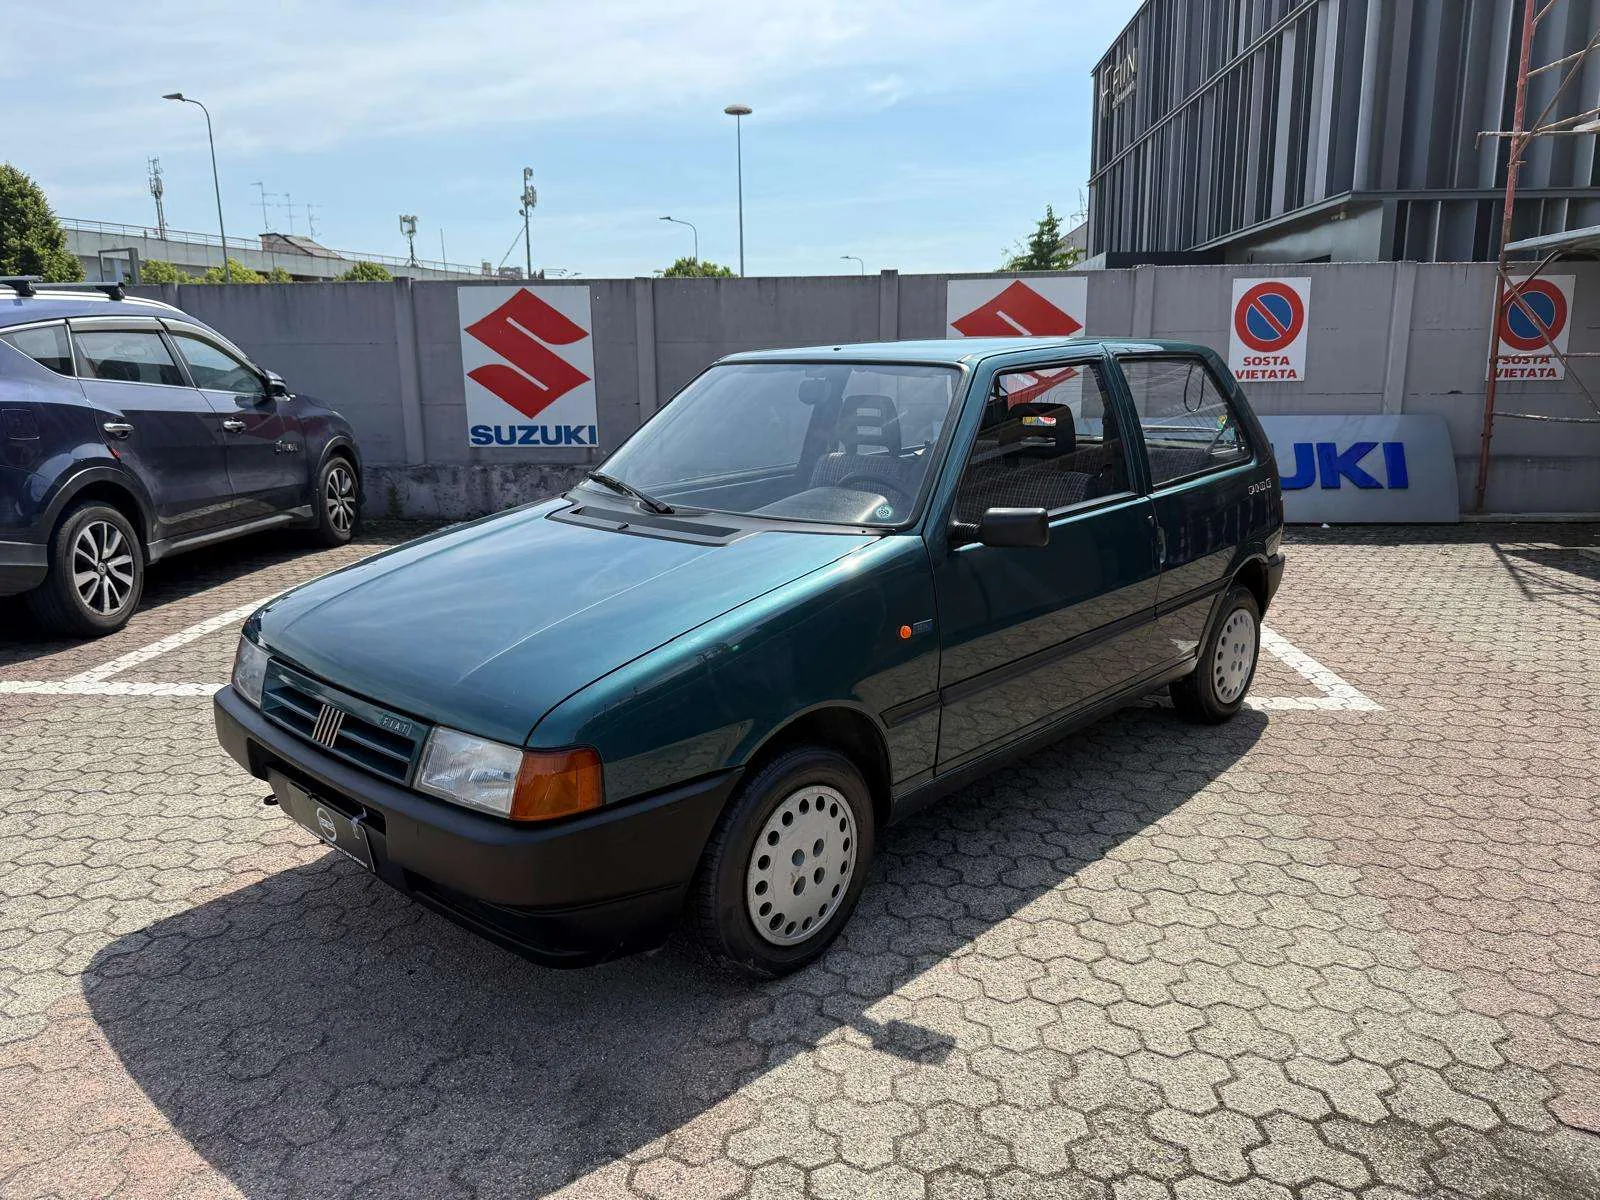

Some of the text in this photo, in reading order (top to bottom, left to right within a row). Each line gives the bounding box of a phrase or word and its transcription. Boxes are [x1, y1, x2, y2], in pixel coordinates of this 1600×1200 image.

[1243, 356, 1290, 366] SOSTA
[1502, 355, 1550, 364] SOSTA
[1235, 369, 1297, 379] VIETATA
[470, 424, 597, 445] SUZUKI
[382, 717, 408, 733] FIAT
